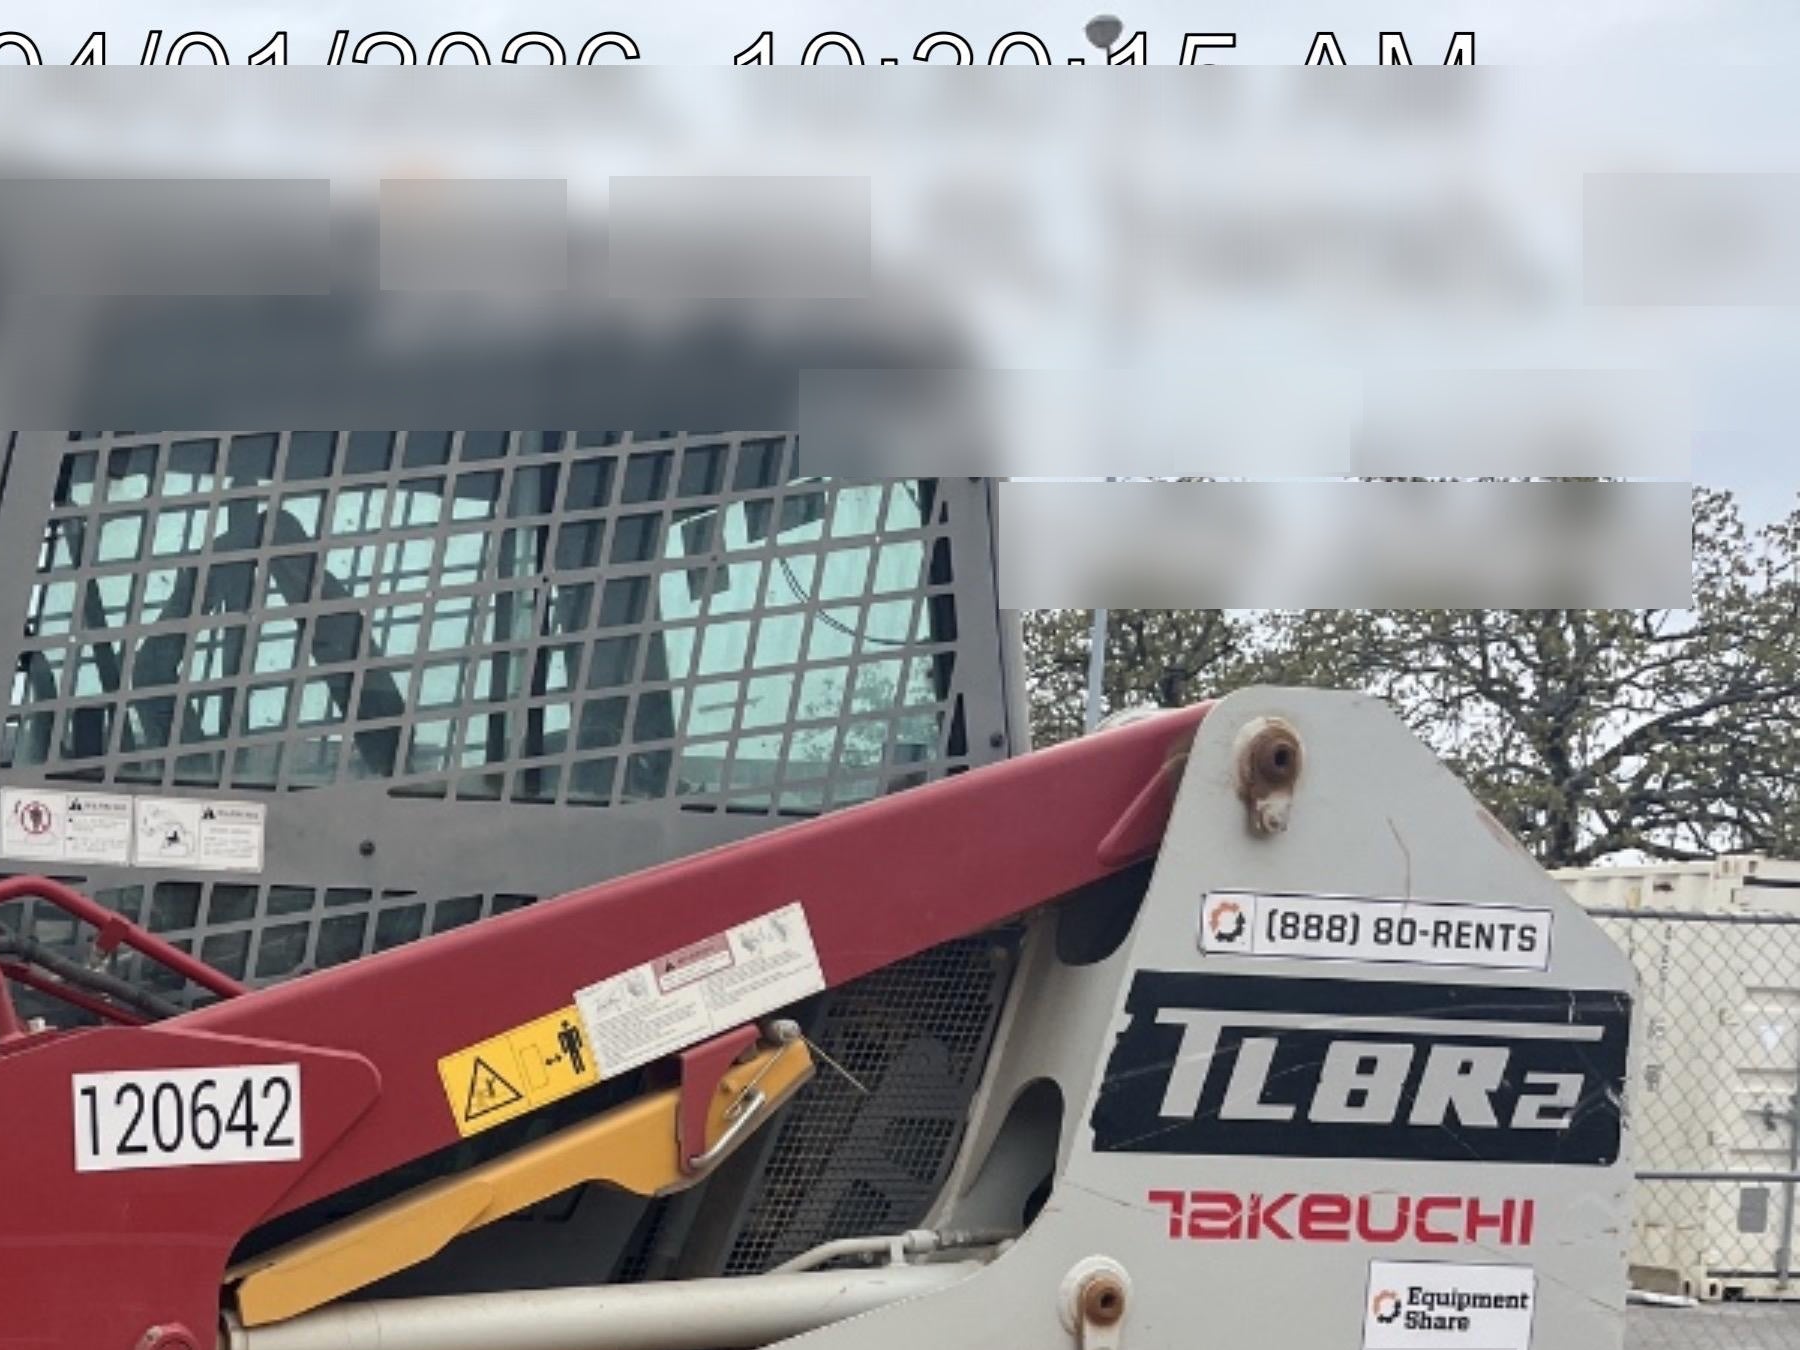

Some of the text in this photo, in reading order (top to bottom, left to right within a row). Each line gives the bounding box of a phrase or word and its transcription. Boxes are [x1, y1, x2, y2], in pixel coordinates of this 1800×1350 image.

[1266, 908, 1538, 952] (888) 80-RENTS
[81, 1076, 294, 1156] 120642
[1407, 1286, 1529, 1312] Equipment
[1404, 1310, 1470, 1331] Share
